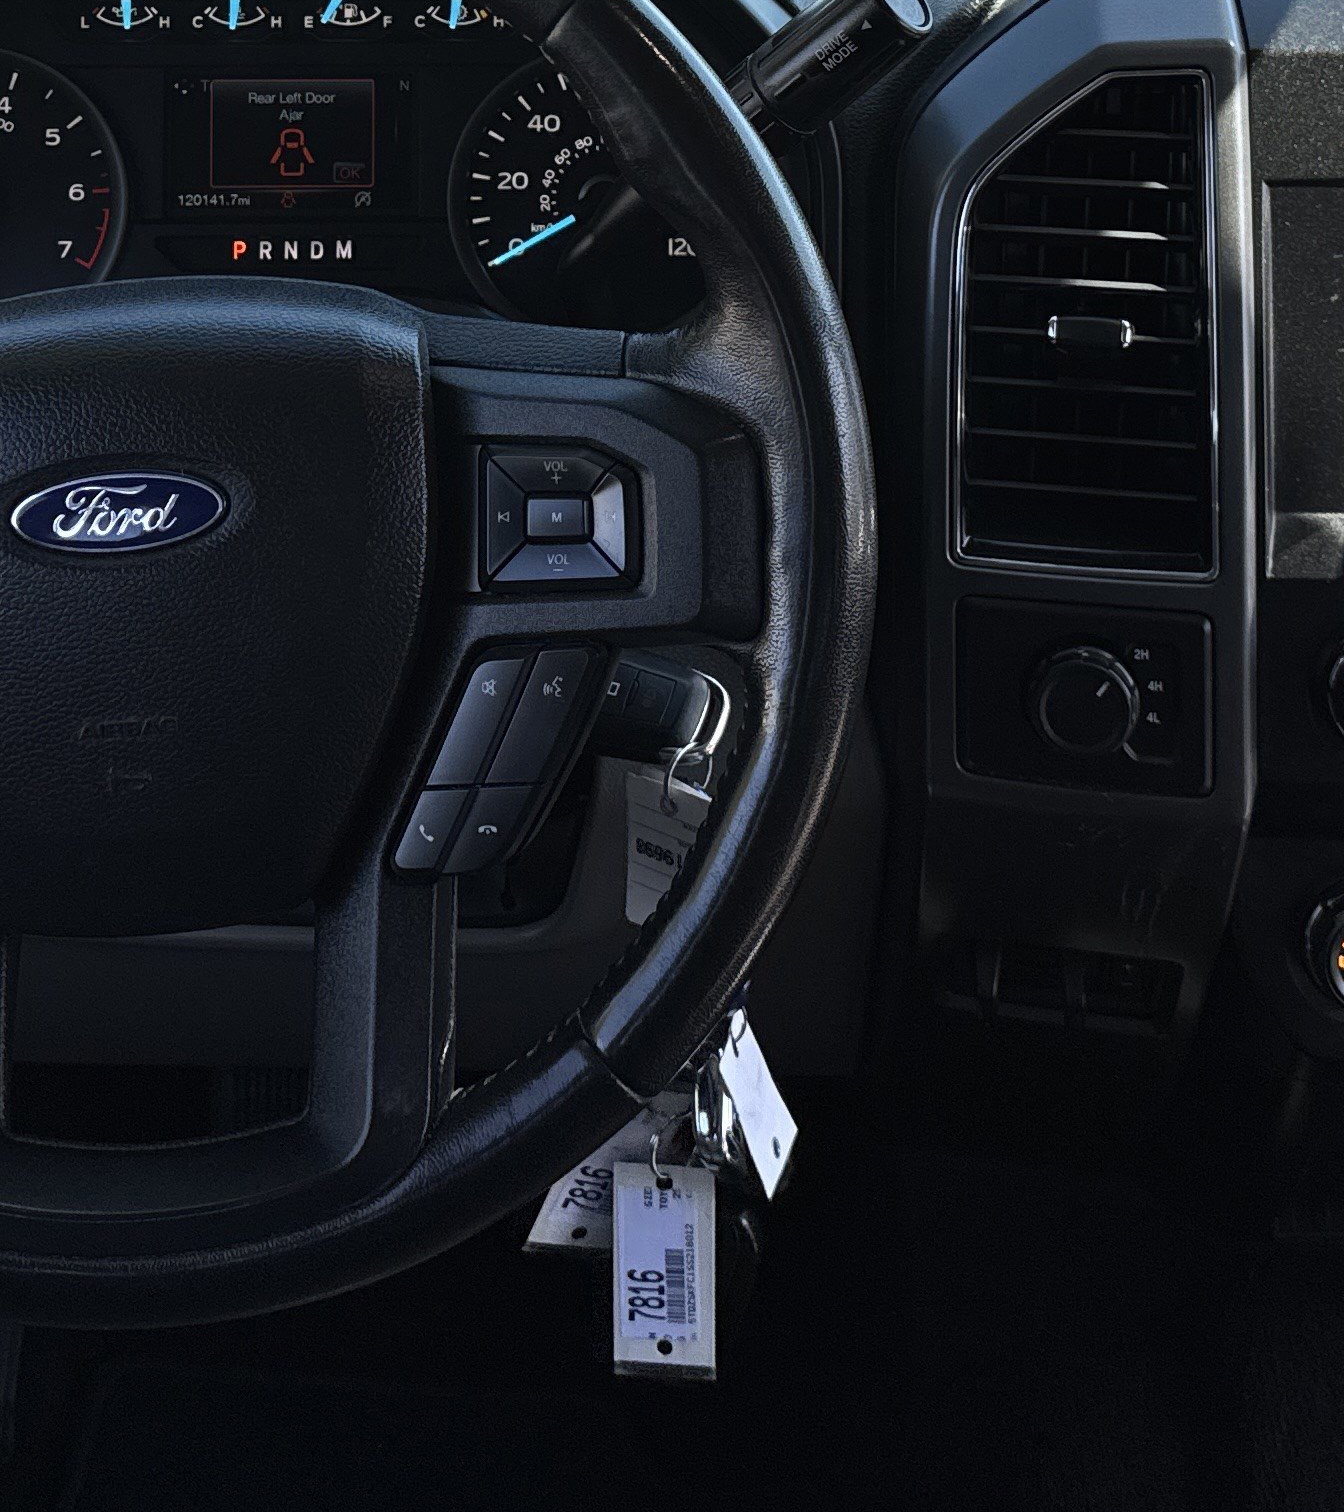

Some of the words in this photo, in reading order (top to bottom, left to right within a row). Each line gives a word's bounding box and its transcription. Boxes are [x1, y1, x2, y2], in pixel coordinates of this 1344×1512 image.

[80, 16, 90, 29] L
[159, 16, 170, 28] H
[192, 16, 204, 28] C
[270, 16, 282, 28] H
[304, 16, 314, 28] E
[383, 16, 393, 28] F
[414, 16, 425, 28] C
[493, 16, 504, 27] H
[815, 29, 849, 61] DRIVE
[822, 40, 859, 72] MODE
[248, 92, 275, 104] Rear
[279, 92, 302, 104] Left
[306, 92, 336, 104] Door
[279, 109, 304, 123] Ajar
[527, 115, 561, 133] 40
[45, 128, 61, 146] 5
[575, 136, 593, 150] 80
[554, 148, 571, 165] 60
[340, 167, 361, 179] OK
[542, 169, 556, 188] 40
[497, 172, 529, 190] 20
[68, 183, 85, 201] 6
[178, 194, 251, 207] 120141.7mi
[540, 194, 551, 212] 20
[57, 240, 72, 258] 7
[233, 241, 247, 260] P
[259, 241, 273, 260] R
[284, 241, 298, 260] N
[310, 241, 324, 260] D
[336, 240, 353, 260] M
[543, 461, 568, 472] VOL
[52, 484, 180, 539] Ford
[551, 512, 562, 523] M
[547, 554, 570, 565] VOL
[1134, 648, 1150, 660] 2H
[1148, 680, 1163, 692] 4H
[1146, 712, 1161, 723] 4L
[562, 1165, 614, 1212] 7816
[628, 1269, 667, 1322] 7816
